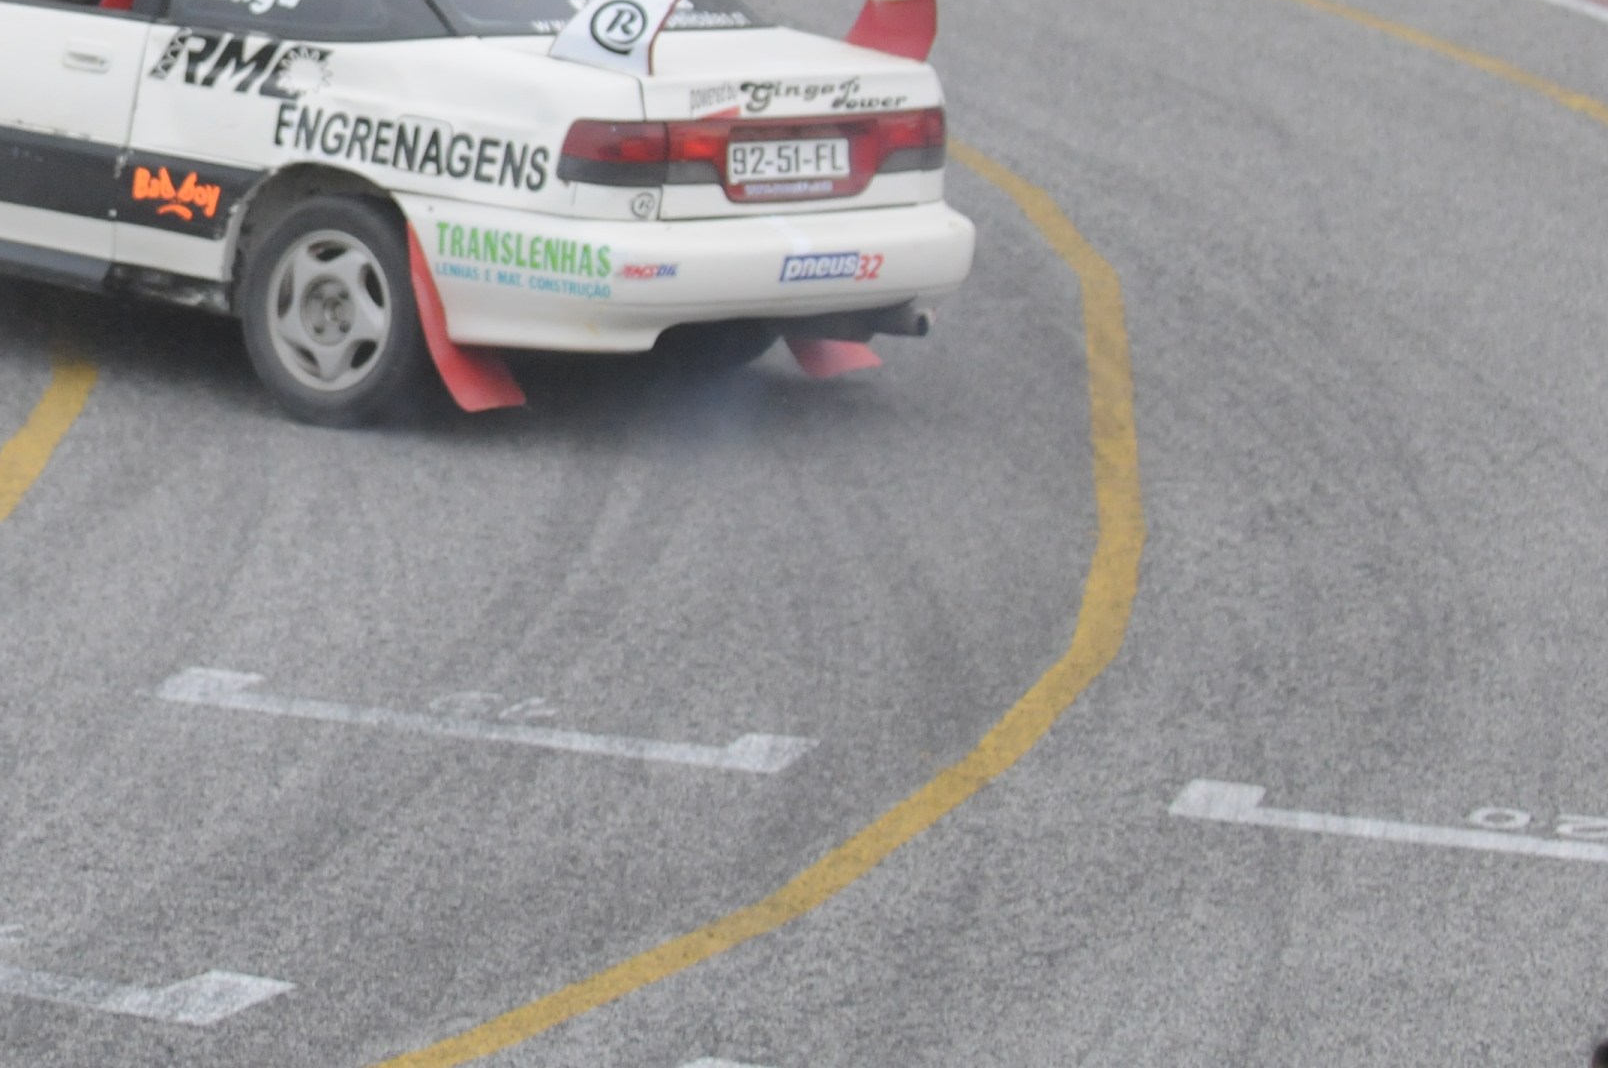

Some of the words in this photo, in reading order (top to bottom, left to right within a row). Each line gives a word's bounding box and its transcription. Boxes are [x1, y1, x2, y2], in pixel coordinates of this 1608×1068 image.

[273, 102, 550, 192] ENGRENAGENS
[732, 143, 844, 175] 92-51-FL
[435, 220, 612, 279] TRANSLENHAS
[435, 262, 480, 282] LENHAS
